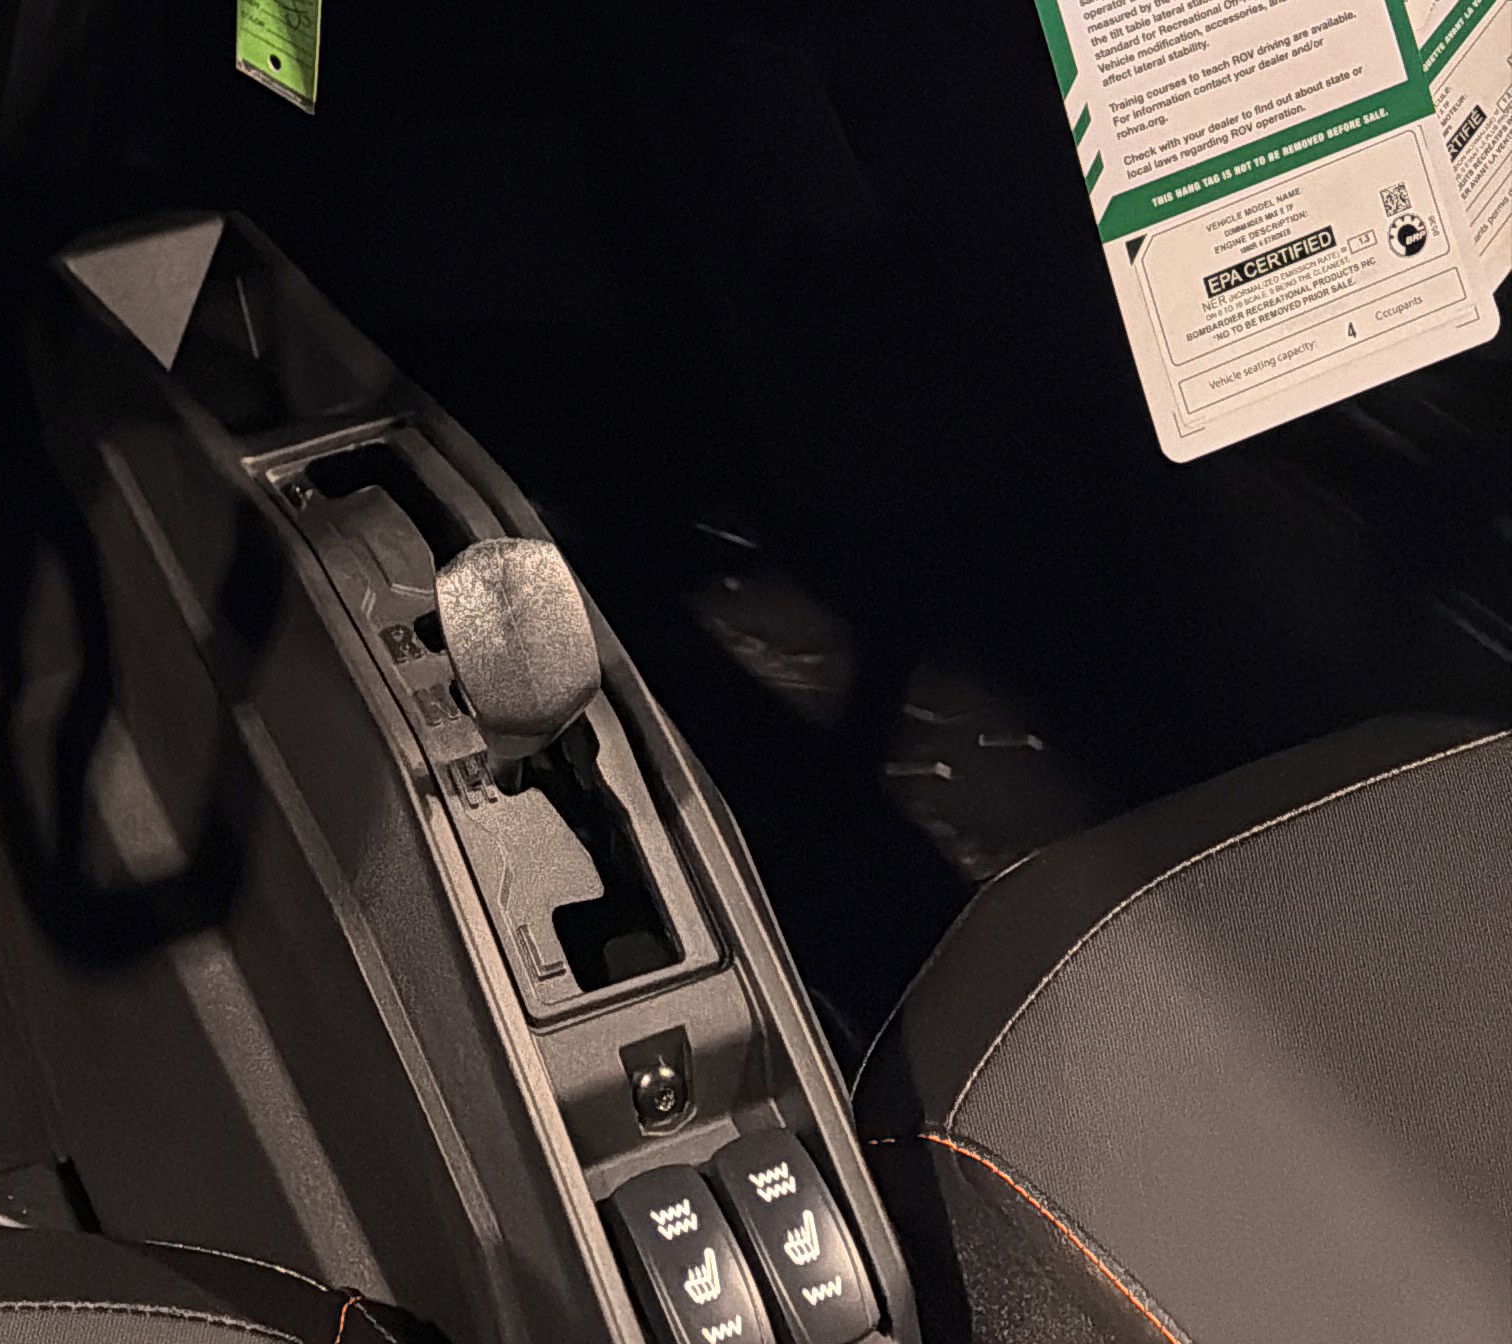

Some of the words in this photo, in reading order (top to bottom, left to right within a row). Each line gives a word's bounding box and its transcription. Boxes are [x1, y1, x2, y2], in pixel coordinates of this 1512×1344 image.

[1086, 5, 1138, 33] measured
[1138, 2, 1151, 13] by
[1090, 34, 1107, 47] the
[1108, 27, 1124, 39] tilt
[1124, 18, 1151, 33] table
[1151, 2, 1185, 23] lateral
[1094, 34, 1140, 60] standard
[1141, 30, 1156, 42] for
[1157, 2, 1222, 35] Recreational
[1096, 53, 1135, 73] Vehicle
[1136, 28, 1203, 59] modification,
[1204, 3, 1267, 32] accessories,
[1102, 68, 1132, 87] affect
[1132, 54, 1166, 75] lateral
[1167, 40, 1209, 61] stability.
[1151, 191, 1174, 207] THIS
[1174, 181, 1201, 198] HANG
[1201, 173, 1220, 187] TAG
[1221, 168, 1232, 180] IS
[1233, 160, 1251, 175] NOT
[1252, 155, 1266, 167] TO
[1267, 149, 1280, 162] BE
[1281, 132, 1324, 156] REMOVED
[1326, 117, 1361, 138] BEFORE
[1362, 107, 1388, 124] SALE.
[1207, 268, 1243, 293] EPA
[1243, 231, 1331, 277] CERTIFIED
[1207, 371, 1241, 389] Vehicle
[1242, 356, 1276, 376] seating
[1347, 321, 1356, 338] 4
[378, 623, 427, 664] R
[412, 683, 461, 726] N
[448, 752, 499, 810] H
[515, 923, 567, 983] L
